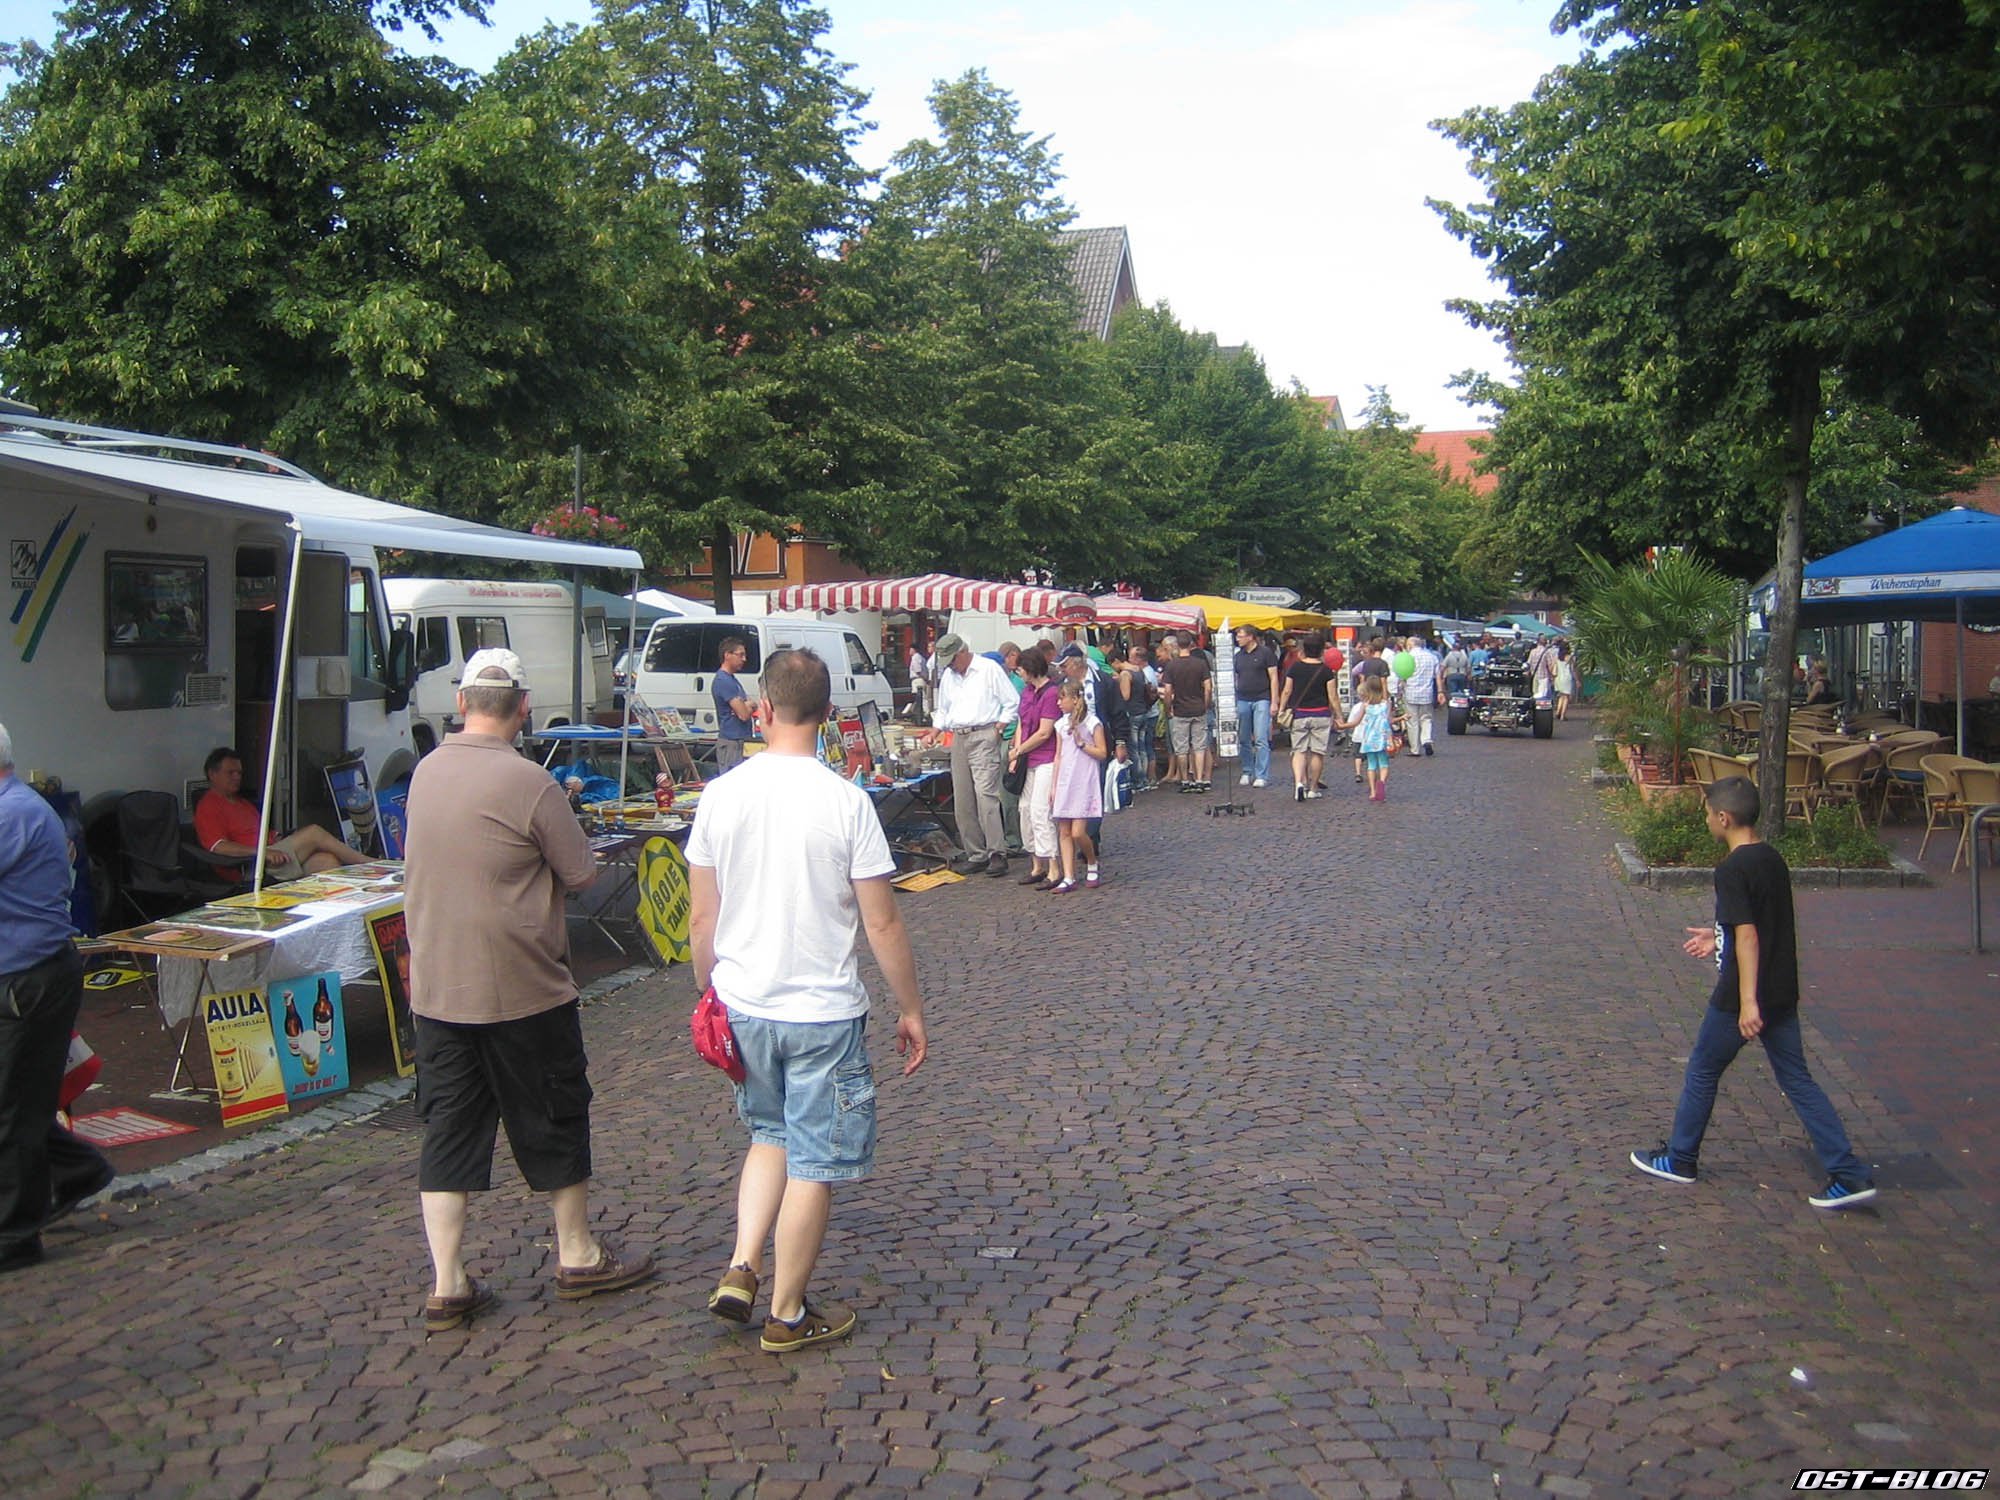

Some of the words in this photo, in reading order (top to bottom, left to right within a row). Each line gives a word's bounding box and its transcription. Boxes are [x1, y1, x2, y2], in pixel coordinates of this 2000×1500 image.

[1870, 577, 1942, 591] Weihenstephan
[652, 862, 680, 915] BOIE
[207, 992, 264, 1023] AULA
